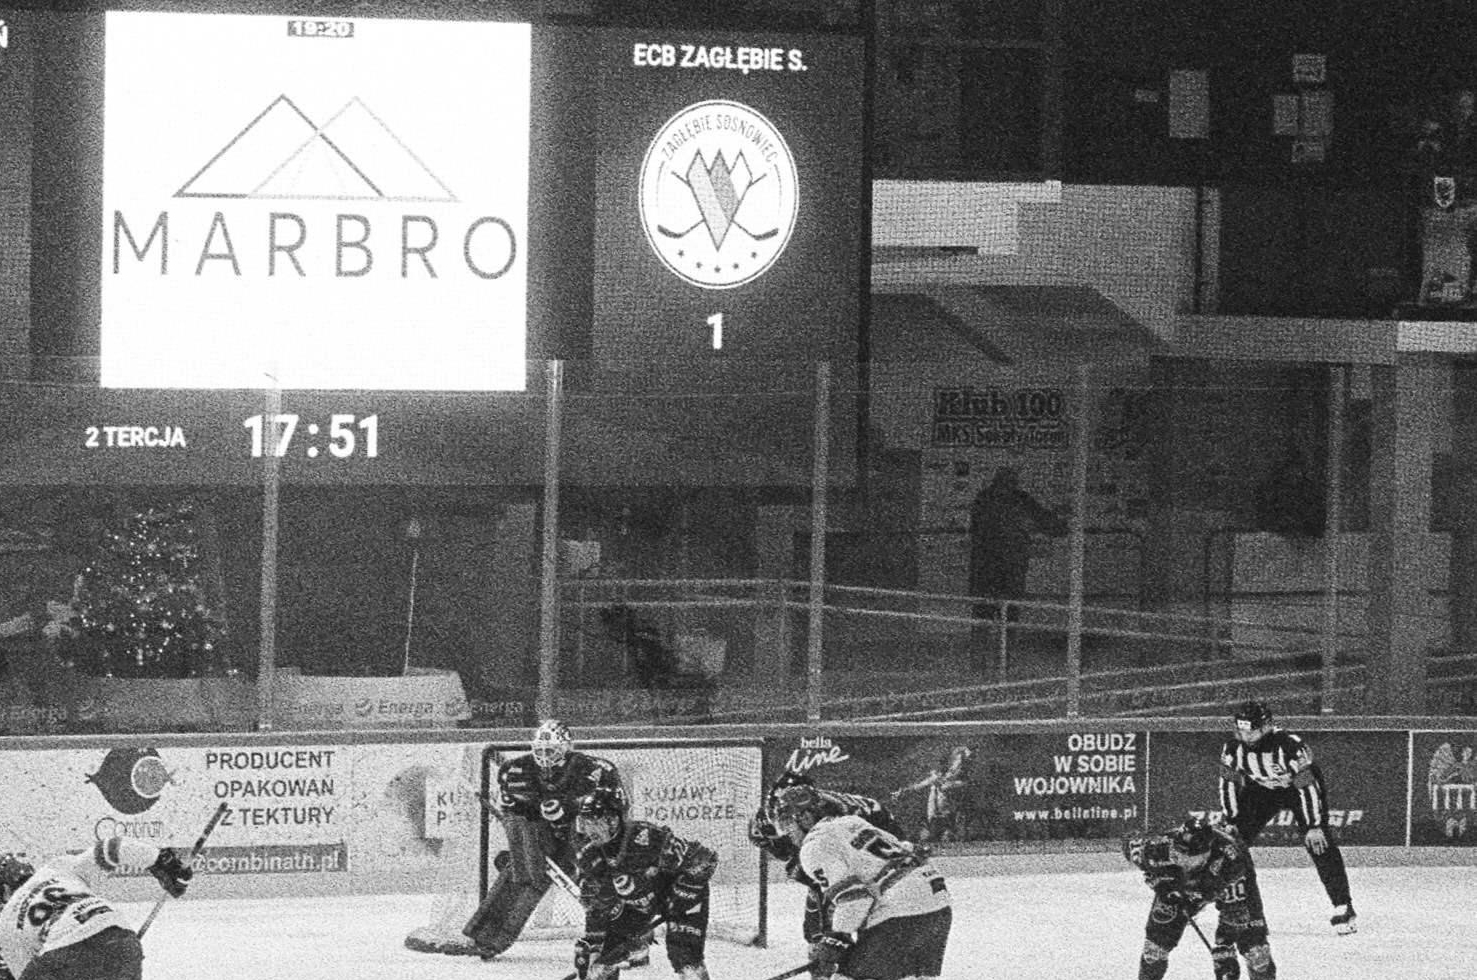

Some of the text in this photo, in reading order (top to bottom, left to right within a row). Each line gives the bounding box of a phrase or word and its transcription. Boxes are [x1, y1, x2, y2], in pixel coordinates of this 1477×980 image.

[290, 20, 352, 37] 19:20
[633, 43, 808, 74] ECB ZAGŁĘBIE S.
[716, 113, 779, 163] SOSNOWIEC
[112, 209, 519, 281] MARBRO
[706, 312, 724, 351] 1
[937, 391, 1062, 416] Klub 100
[85, 426, 187, 448] 2 TERCJA
[244, 413, 379, 459] 17:51
[379, 700, 434, 718] Energa
[800, 735, 833, 749] bella
[205, 751, 335, 770] PRODUCENT
[785, 745, 850, 773] line
[1053, 754, 1137, 773] W SOBIE
[1013, 775, 1137, 796] WOJOWNIKA
[220, 807, 335, 826] Z TEKTURY
